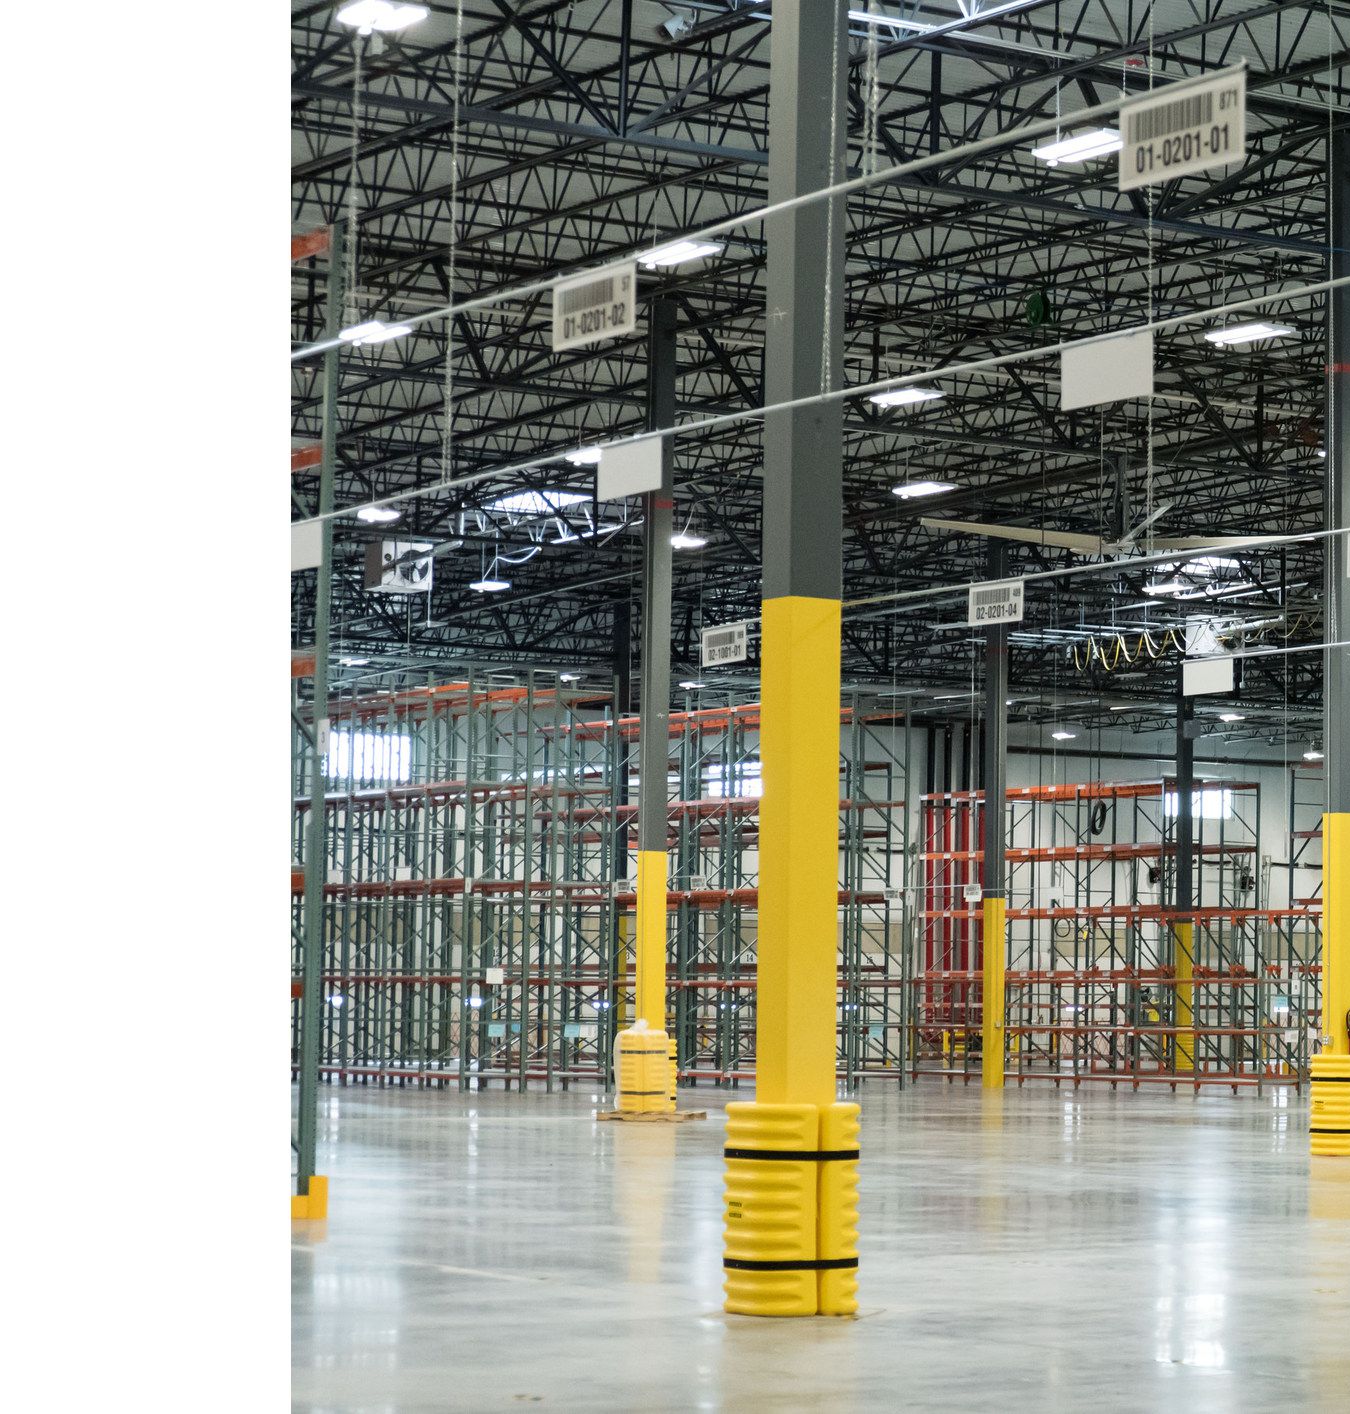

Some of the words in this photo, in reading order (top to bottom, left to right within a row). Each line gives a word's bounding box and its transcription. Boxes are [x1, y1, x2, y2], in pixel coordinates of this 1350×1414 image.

[1219, 89, 1238, 110] 871
[1135, 123, 1229, 174] 01-0201-01
[563, 302, 626, 339] 01-0201-02
[975, 602, 1018, 620] 02-0201-04
[707, 644, 741, 662] 02-1001-01
[746, 954, 754, 962] 14
